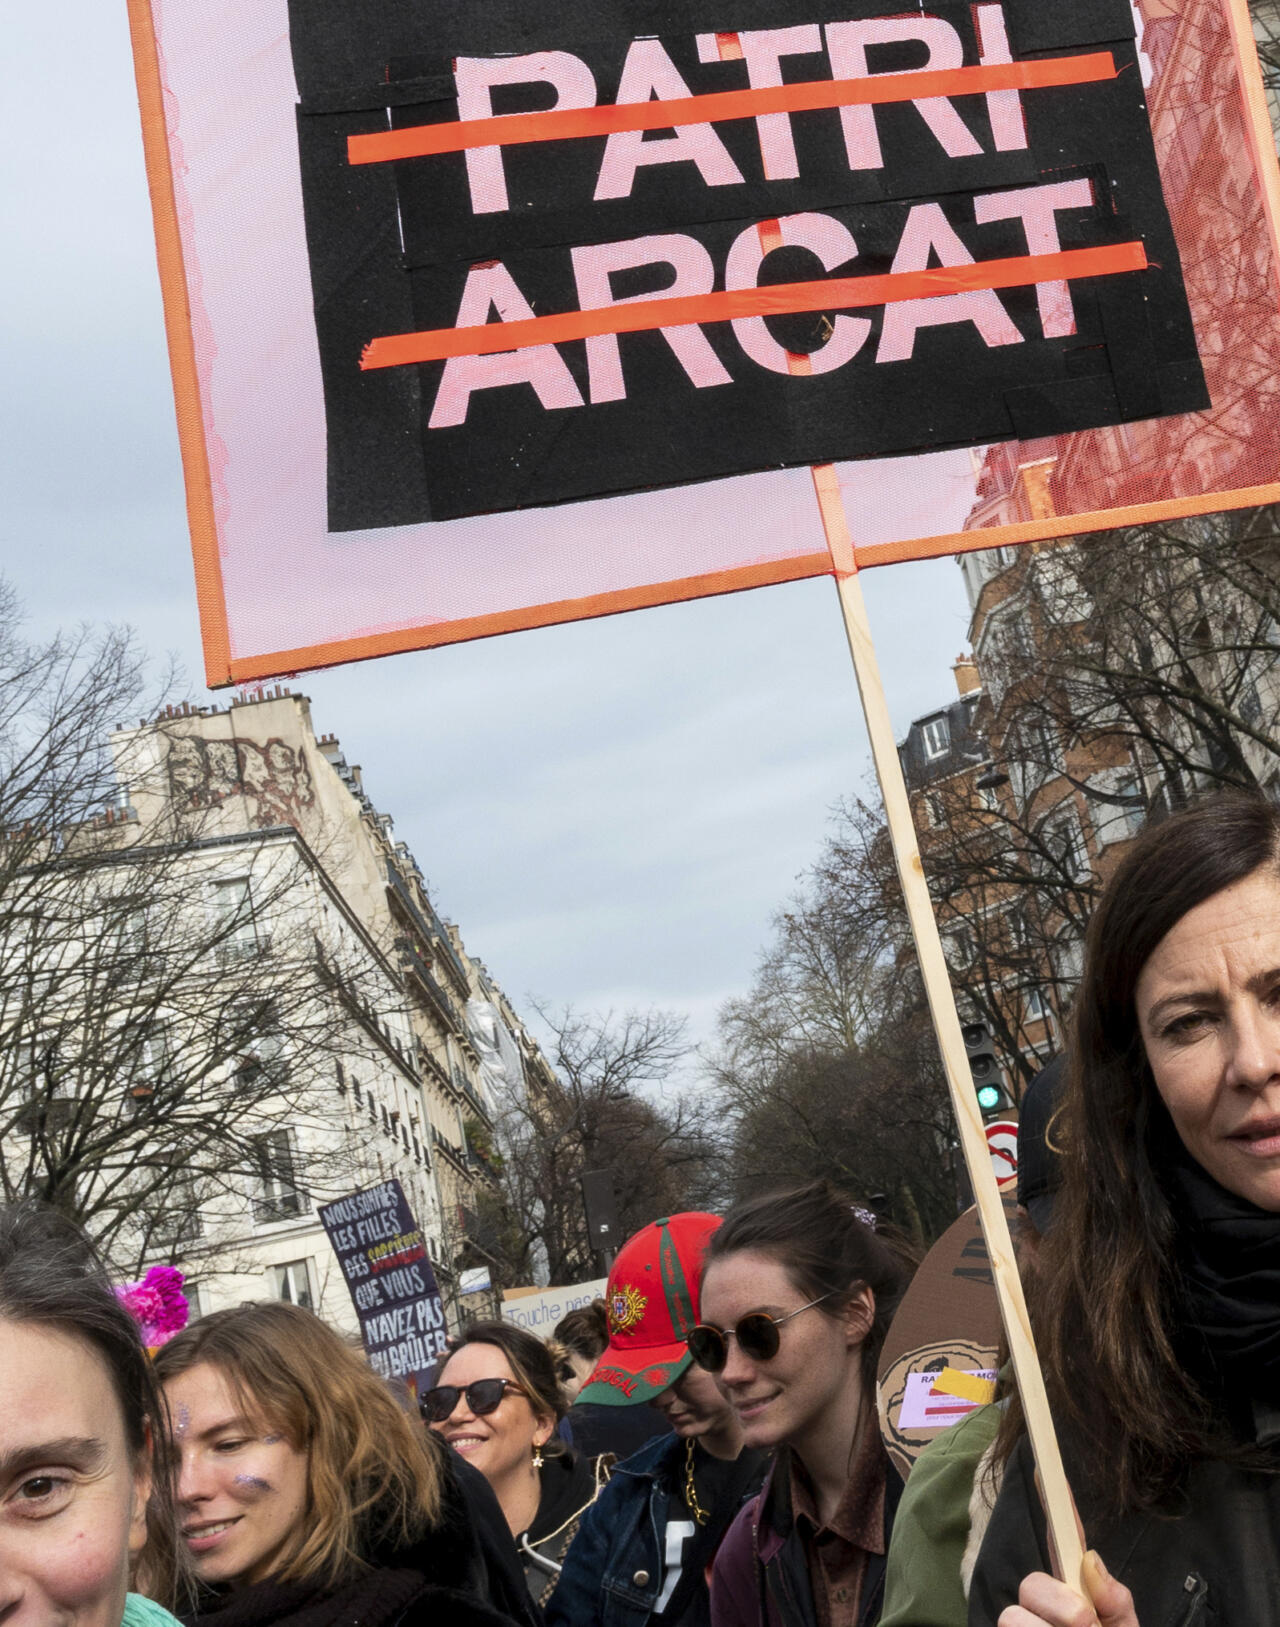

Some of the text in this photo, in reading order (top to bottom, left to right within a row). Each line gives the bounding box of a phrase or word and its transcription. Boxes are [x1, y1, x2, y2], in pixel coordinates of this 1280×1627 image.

[453, 3, 1027, 215] PATRI
[427, 178, 1095, 430] ARCAT
[322, 1181, 399, 1228] NOUS SOMMES
[332, 1208, 402, 1252] LES FILLES
[344, 1252, 370, 1280] DES
[355, 1264, 425, 1310] QUE VOUS
[364, 1296, 445, 1345] N'AVEZ PAS
[507, 1298, 561, 1330] Touche
[388, 1329, 448, 1375] BRÛLER
